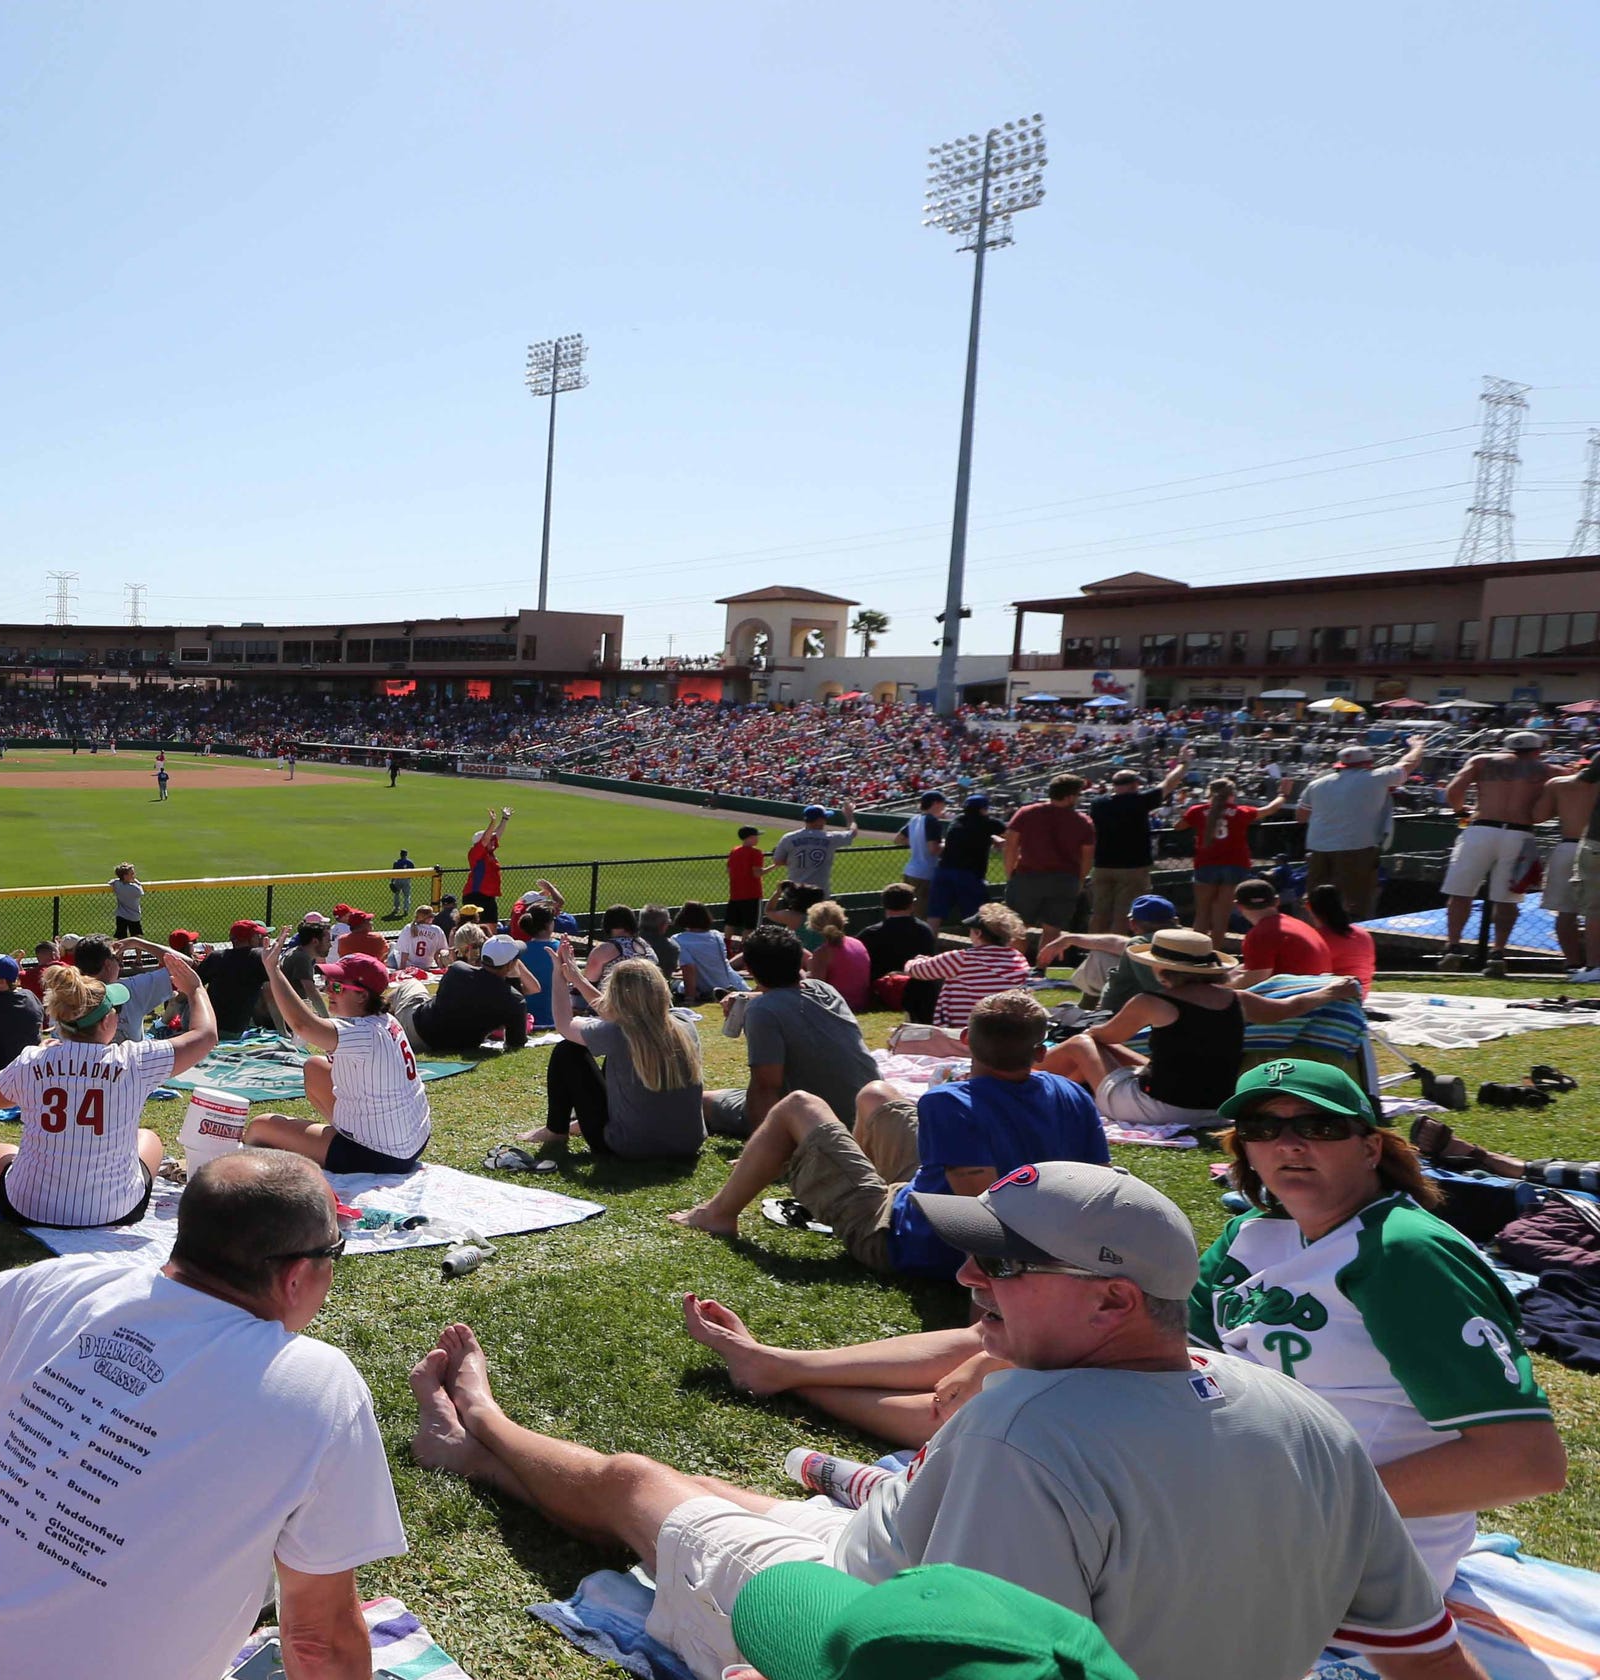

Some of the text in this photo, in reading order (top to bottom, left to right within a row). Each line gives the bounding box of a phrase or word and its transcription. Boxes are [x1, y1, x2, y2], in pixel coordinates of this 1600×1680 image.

[462, 763, 508, 774] HOOTERS
[794, 848, 826, 868] 19
[416, 941, 426, 957] 6
[33, 1059, 123, 1083] HALLADAY
[400, 1040, 416, 1081] 5
[1264, 1061, 1296, 1086] P
[40, 1087, 104, 1137] 34
[988, 1163, 1040, 1193] P
[79, 1334, 165, 1384] DIAMOND
[1263, 1330, 1313, 1379] P
[1461, 1316, 1520, 1385] P
[42, 1365, 158, 1438] Mainland vs. Riverside
[93, 1358, 147, 1397] CLASSIC
[32, 1381, 151, 1457] Ocean City vs. Kingsway
[3, 1439, 37, 1472] Burlington
[9, 1430, 101, 1506] Northern vs. Buena
[16, 1416, 53, 1447] Augustine
[58, 1447, 70, 1460] vs.
[79, 1459, 119, 1488] Eastern
[70, 1429, 81, 1441] vs.
[88, 1440, 143, 1476] Paulsboro
[7, 1466, 30, 1488] Valley
[35, 1488, 48, 1502] vs.
[56, 1501, 125, 1547] Haddonfield
[25, 1508, 38, 1522] vs.
[48, 1517, 107, 1557] Gloucester
[44, 1526, 89, 1557] Catholic
[15, 1527, 28, 1541] vs.
[36, 1541, 70, 1567] Bishop
[70, 1561, 108, 1588] Eustace
